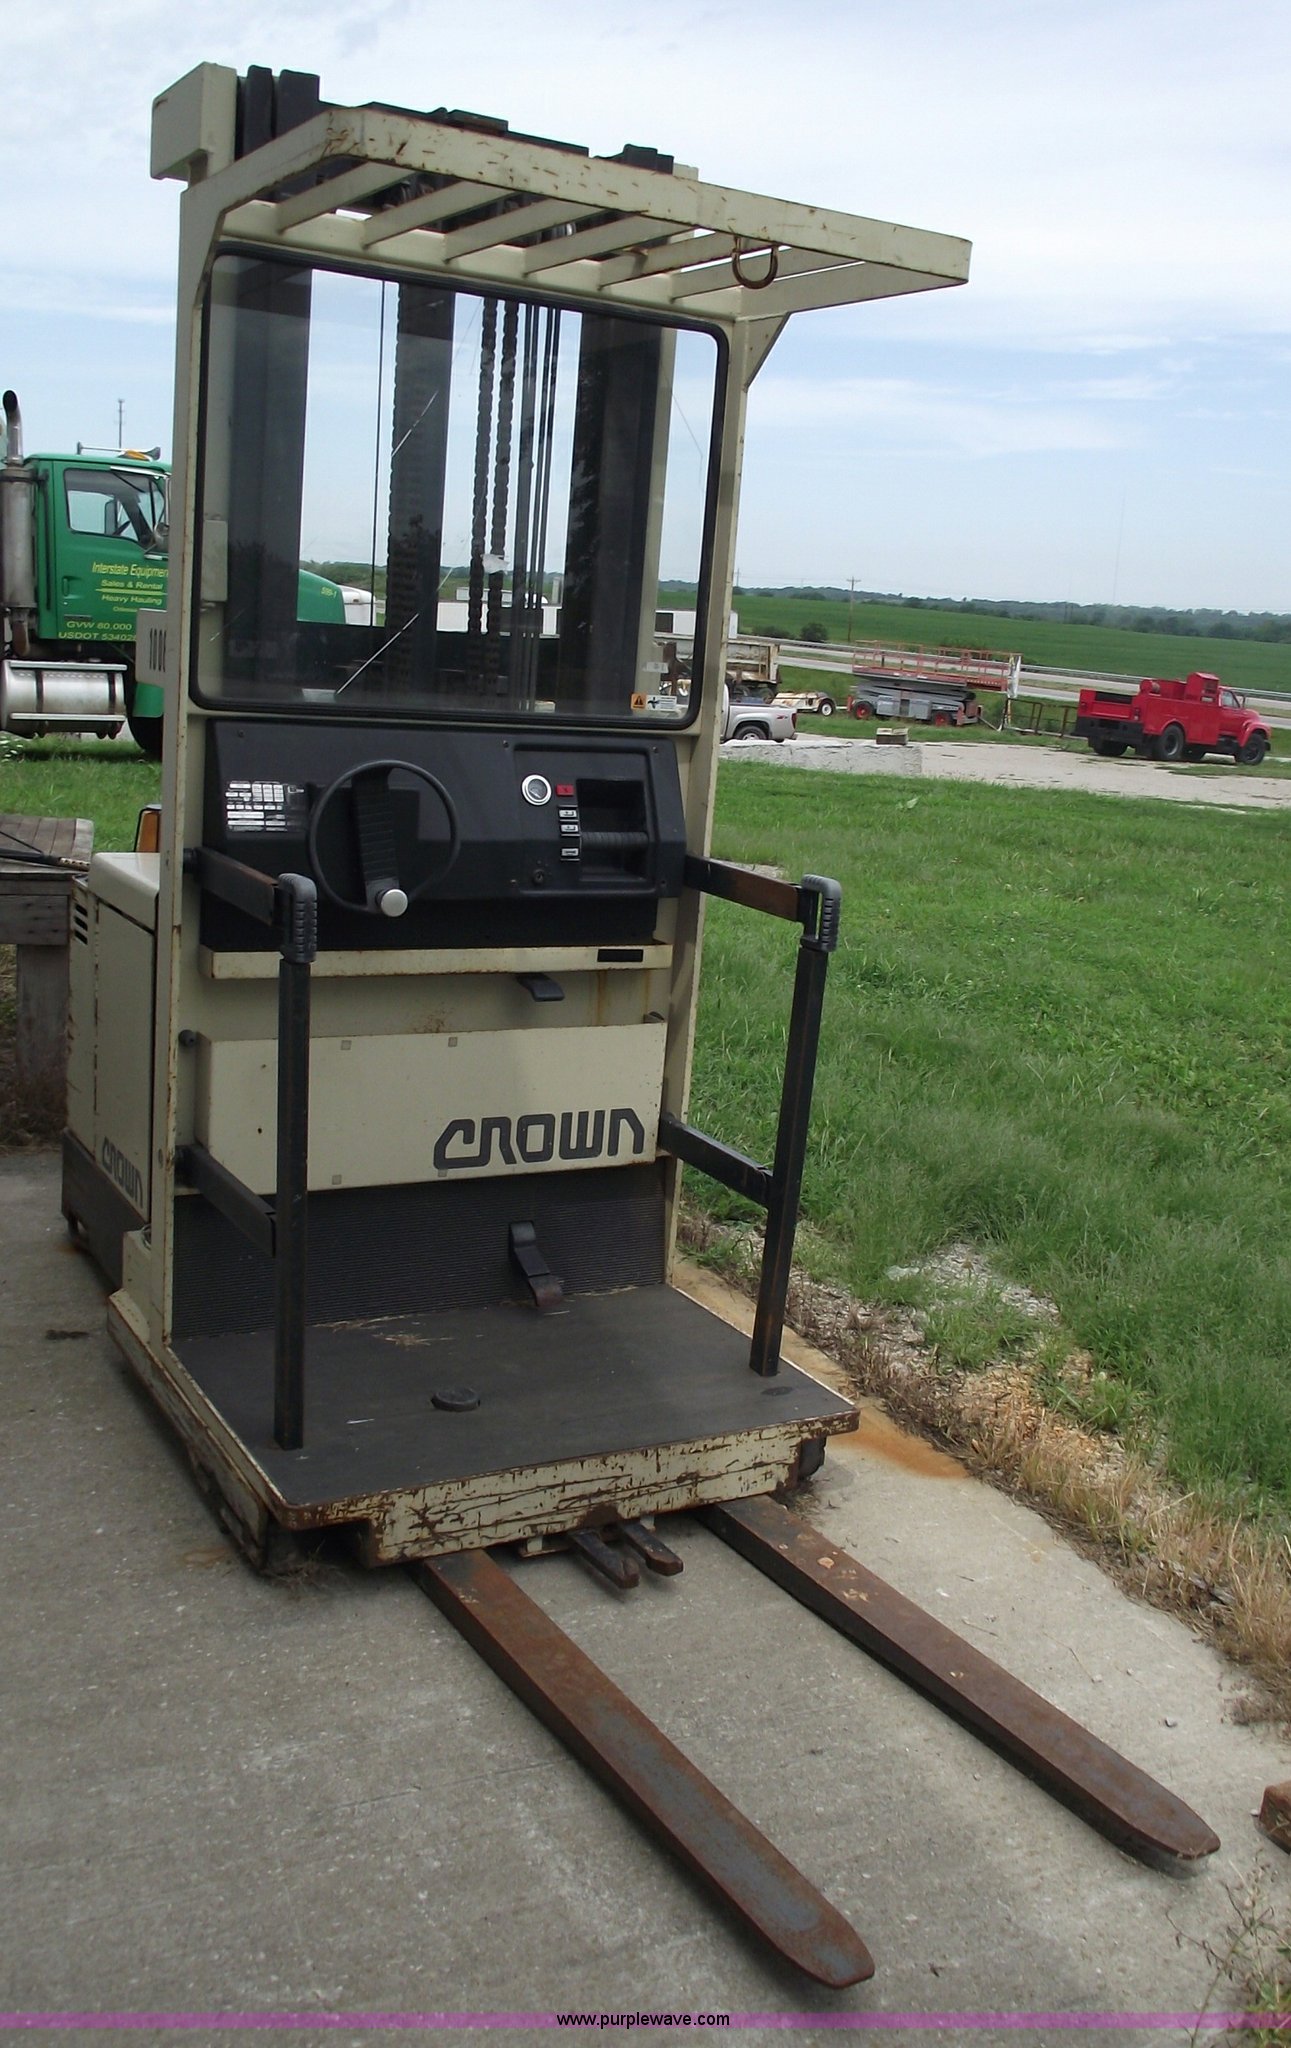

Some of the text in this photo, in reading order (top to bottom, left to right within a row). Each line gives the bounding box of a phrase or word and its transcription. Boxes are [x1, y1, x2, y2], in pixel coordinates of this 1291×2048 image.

[92, 562, 129, 576] Interstate
[101, 580, 125, 588] Sales
[136, 581, 163, 590] Rental
[101, 594, 162, 605] Heavy Hauling
[66, 620, 95, 629] GVW
[58, 631, 99, 640] USDOT
[433, 1108, 645, 1169] CROWN
[102, 1136, 143, 1209] CROWN
